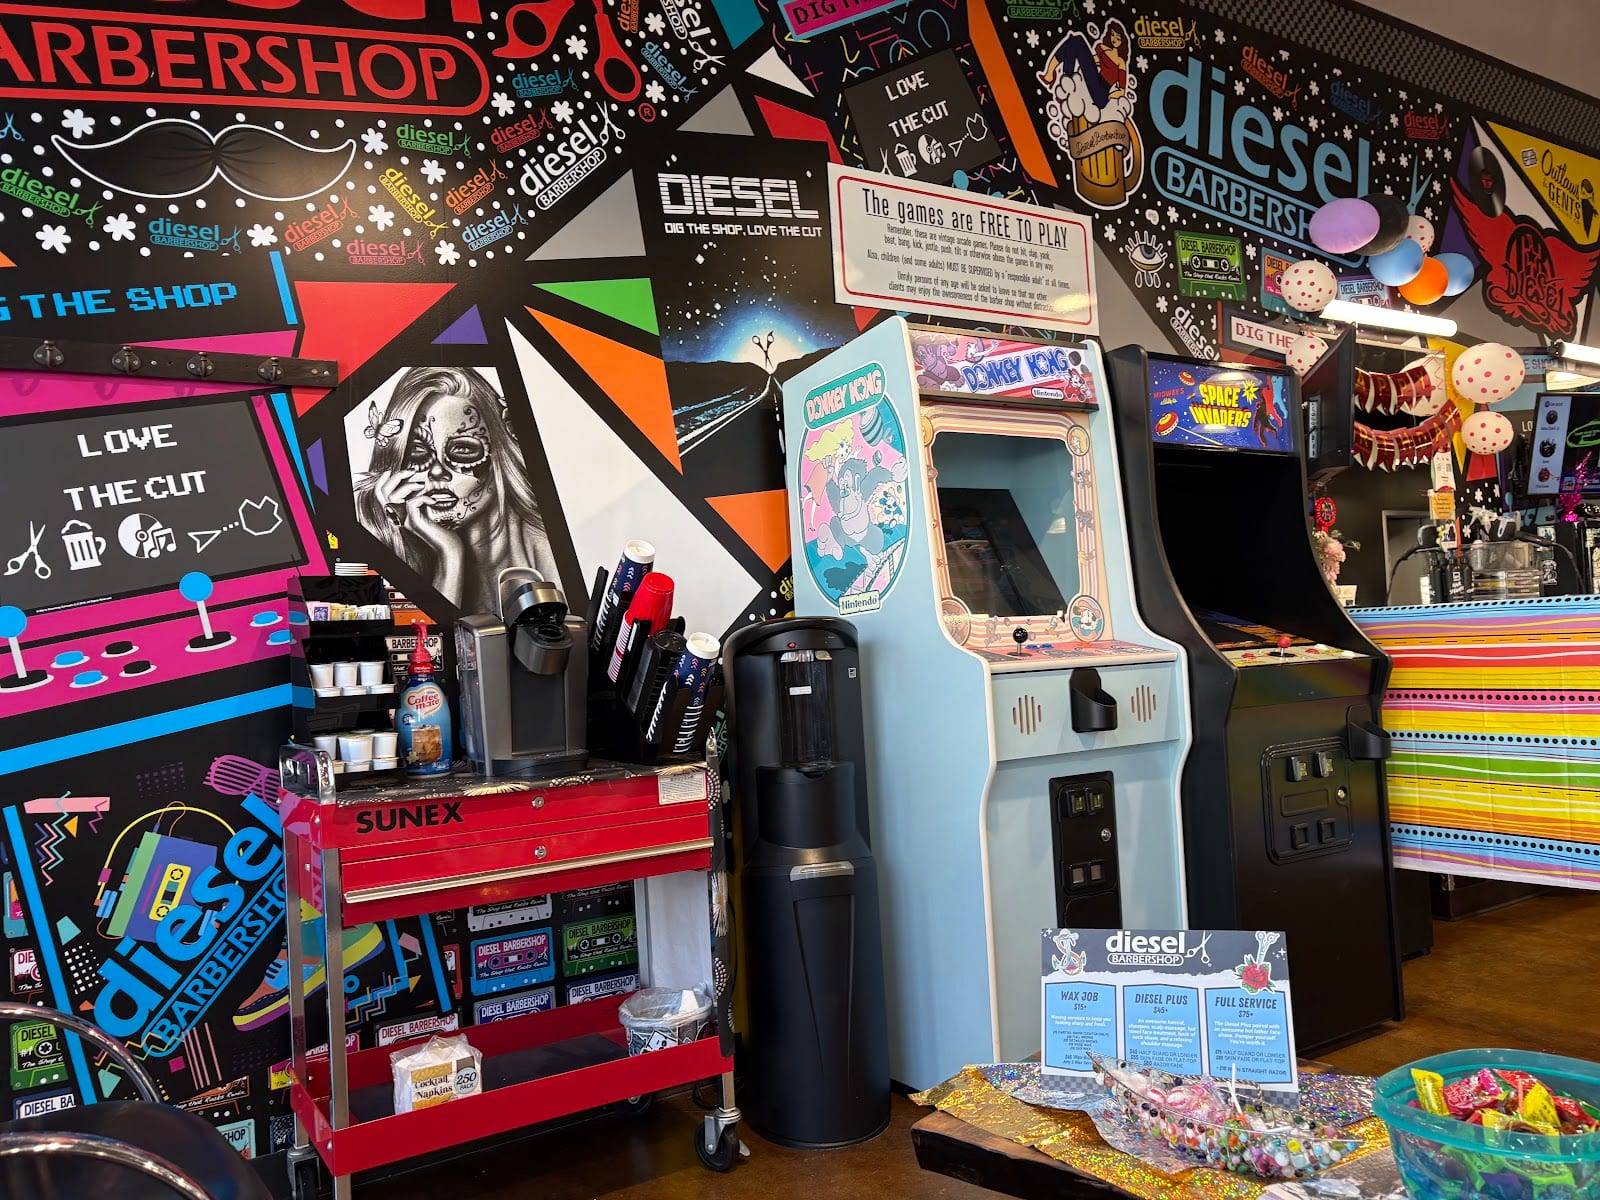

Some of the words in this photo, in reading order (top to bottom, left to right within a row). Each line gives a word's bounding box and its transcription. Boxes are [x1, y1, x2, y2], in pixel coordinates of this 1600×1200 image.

[792, 1, 836, 25] DIG
[1010, 8, 1060, 18] BARBERSHOP
[1134, 16, 1184, 36] diesel
[1141, 39, 1183, 47] BARBERSHOP
[0, 21, 457, 101] ARBERSHOP
[643, 49, 677, 88] BARBERSHOP
[645, 41, 687, 85] diesel
[1242, 46, 1288, 89] diesel
[512, 70, 562, 89] diesel
[885, 70, 929, 101] LOVE
[518, 86, 562, 97] BARBERSHOP
[1331, 81, 1370, 114] diesel
[490, 114, 537, 145] diesel
[888, 112, 923, 137] THE
[921, 100, 949, 124] CUT
[1150, 57, 1370, 201] diesel
[1404, 111, 1439, 129] diesel
[396, 124, 453, 146] diesel
[499, 130, 539, 152] BARBERSHOP
[400, 140, 451, 154] BARBERSHOP
[520, 119, 598, 196] diesel
[1, 168, 79, 209] diesel
[446, 168, 490, 208] diesel
[540, 150, 602, 206] BARBERSHOP
[2, 184, 68, 216] BARBERSHOP
[381, 177, 421, 222] BARBERSHOP
[385, 168, 436, 220] diesel
[456, 184, 493, 214] BARBERSHOP
[658, 173, 819, 219] DIESEL
[1549, 182, 1580, 220] GENTS
[148, 217, 220, 241] diesel
[284, 204, 339, 243] diesel
[462, 210, 510, 243] diesel
[862, 188, 889, 215] The
[898, 199, 943, 224] games
[951, 210, 973, 231] are
[980, 211, 1010, 238] FREE
[1017, 217, 1032, 241] TO
[1039, 222, 1067, 248] PLAY
[296, 222, 340, 250] BARBERSHOP
[471, 226, 511, 250] BARBERSHOP
[664, 223, 685, 234] DIG
[686, 223, 710, 235] THE
[748, 225, 777, 236] LOVE
[778, 226, 800, 237] THE
[802, 227, 822, 237] CUT
[154, 236, 217, 250] BARBERSHOP
[346, 240, 406, 256] diesel
[1005, 245, 1010, 253] do
[1181, 239, 1200, 251] DIESEL
[1201, 240, 1236, 255] BARBERSHOP
[352, 256, 403, 264] BARBERSHOP
[881, 251, 899, 262] children
[914, 259, 927, 267] some
[946, 261, 959, 271] MUST
[961, 264, 967, 273] BE
[968, 265, 993, 277] SUPERVISED
[994, 270, 1000, 280] by
[1266, 256, 1283, 268] DIESEL
[918, 286, 930, 297] enjoy
[932, 287, 940, 296] the
[974, 292, 979, 301] of
[934, 276, 939, 285] of
[941, 280, 949, 288] any
[951, 280, 959, 289] age
[961, 281, 969, 290] will
[971, 282, 977, 291] be
[1018, 288, 1027, 298] that
[1340, 283, 1355, 294] DIESEL
[20, 289, 116, 319] THE
[127, 282, 238, 312] SHOP
[1175, 306, 1219, 360] diesel
[1236, 323, 1263, 342] DIG
[1267, 331, 1293, 348] THE
[961, 356, 1023, 393] DONKEY
[1025, 348, 1069, 379] KONG
[806, 385, 846, 423] DONKEY
[849, 370, 882, 403] KONG
[1034, 389, 1062, 398] Nintendo
[1153, 387, 1185, 398] MIDWAY'S
[1199, 382, 1240, 407] SPACE
[1189, 404, 1251, 428] INVADERS
[77, 424, 177, 457] LOVE
[63, 480, 142, 511] THE
[144, 470, 207, 501] CUT
[841, 596, 877, 610] Nintendo
[407, 692, 439, 706] Coffee
[415, 698, 440, 711] mate
[356, 802, 463, 833] SUNEX
[94, 793, 284, 1037] diesel
[569, 927, 591, 937] DIESEL
[592, 919, 631, 934] BARBERSHOP
[479, 943, 500, 956] DIESEL
[503, 935, 546, 950] BARBERSHOP
[1106, 931, 1185, 953] diesel
[1112, 954, 1179, 964] BARBERSHOP
[571, 986, 592, 997] DIESEL
[594, 977, 634, 991] BARBERSHOP
[1061, 991, 1079, 1001] WAX
[1081, 991, 1099, 1001] JOB
[481, 1005, 504, 1017] DIESEL
[506, 994, 549, 1012] BARBERSHOP
[1135, 993, 1163, 1004] DIESEL
[1165, 994, 1188, 1005] PLUS
[1153, 1006, 1168, 1014] $45+
[1215, 996, 1236, 1007] FULL
[1238, 997, 1277, 1009] SERVICE
[1238, 1010, 1253, 1018] $75+
[21, 1025, 53, 1041] DIESEL
[382, 1025, 406, 1038] DIESEL
[409, 1014, 456, 1033] BARBERSHOP
[415, 1074, 449, 1089] Cocktail
[455, 1072, 477, 1086] 250
[459, 1082, 474, 1090] PACK
[415, 1085, 453, 1099] Napkins
[24, 1100, 56, 1116] DIESEL
